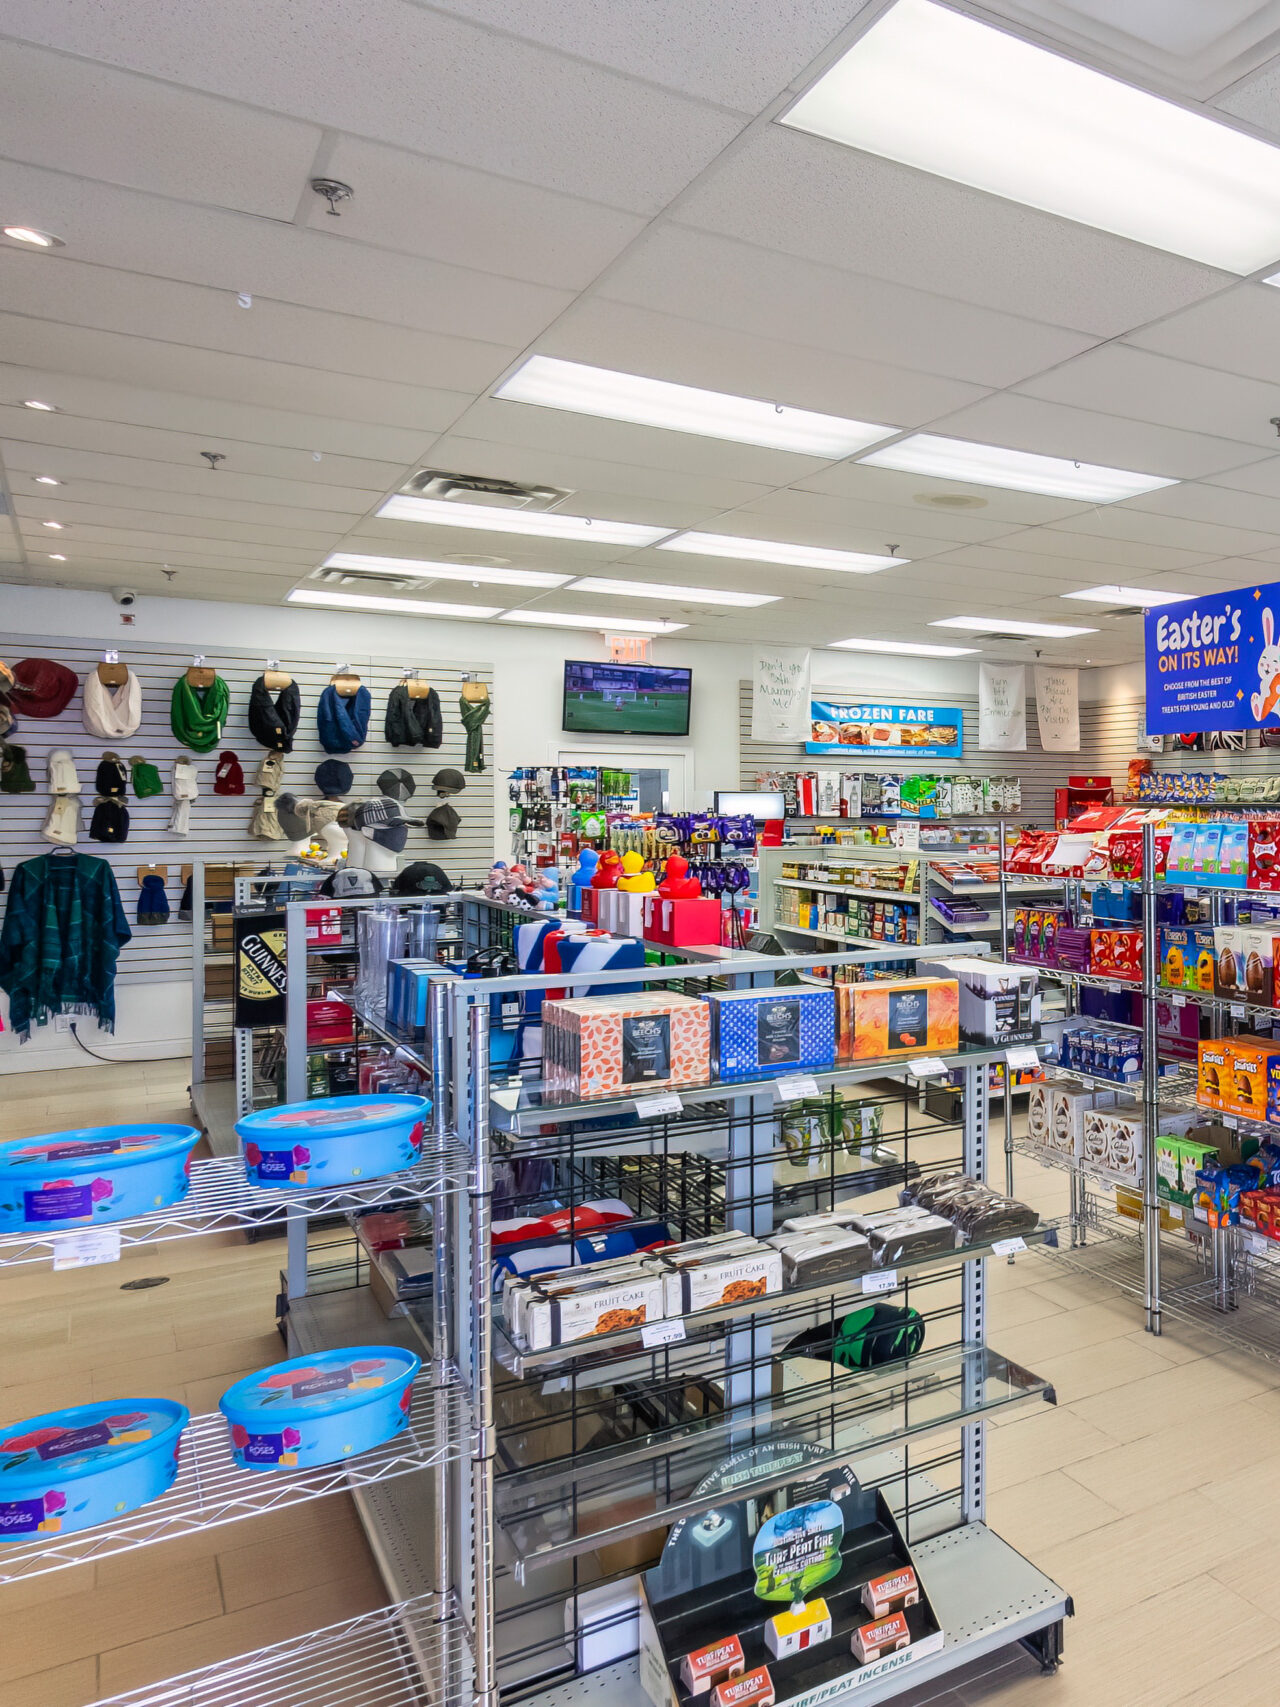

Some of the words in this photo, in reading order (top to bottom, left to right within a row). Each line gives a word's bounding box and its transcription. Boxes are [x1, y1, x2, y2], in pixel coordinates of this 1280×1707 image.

[1156, 604, 1242, 652] Easter's
[611, 637, 648, 660] EXIT
[1158, 653, 1178, 673] ON
[1181, 650, 1201, 670] ITS
[1203, 645, 1239, 667] WAY!
[1163, 681, 1184, 691] CHOOSE
[1184, 680, 1200, 688] FROM
[1200, 678, 1210, 687] THE
[1210, 677, 1224, 686] BEST
[1225, 676, 1233, 684] OF
[1177, 691, 1197, 701] BRITISH
[1198, 690, 1217, 699] EASTER
[831, 706, 893, 721] FROZEN
[899, 709, 934, 722] FARE
[1161, 704, 1180, 714] TREATS
[1180, 704, 1190, 712] FOR
[1190, 702, 1209, 711] YOUNG
[1210, 701, 1222, 710] AND
[1221, 700, 1235, 708] OLD!
[242, 968, 259, 985] STOUT
[246, 964, 264, 983] EXTRA
[1000, 1032, 1034, 1043] GUINNESS
[262, 1163, 287, 1172] ROSES
[720, 1267, 745, 1280] FRUIT
[745, 1263, 766, 1273] CAKE
[594, 1297, 620, 1309] FRUIT
[622, 1291, 645, 1302] CAKE
[301, 1377, 345, 1390] ROSES
[48, 1434, 102, 1451] ROSES
[249, 1446, 275, 1456] ROSES
[721, 1472, 750, 1487] IRISH
[668, 1526, 683, 1547] THE
[720, 1454, 747, 1473] SMELL
[748, 1448, 760, 1457] OF
[762, 1444, 776, 1453] AN
[776, 1442, 801, 1450] IRISH
[801, 1444, 826, 1455] TURF
[765, 1550, 788, 1566] TURF
[789, 1540, 813, 1559] PEAT
[814, 1533, 834, 1549] FIRE
[876, 1573, 910, 1593] TURF/PEAT
[866, 1620, 900, 1639] TURF/PEAT
[696, 1644, 735, 1666] TURF/PEAT
[858, 1651, 913, 1683] INCENSE
[724, 1675, 764, 1698] TURF/PEAT
